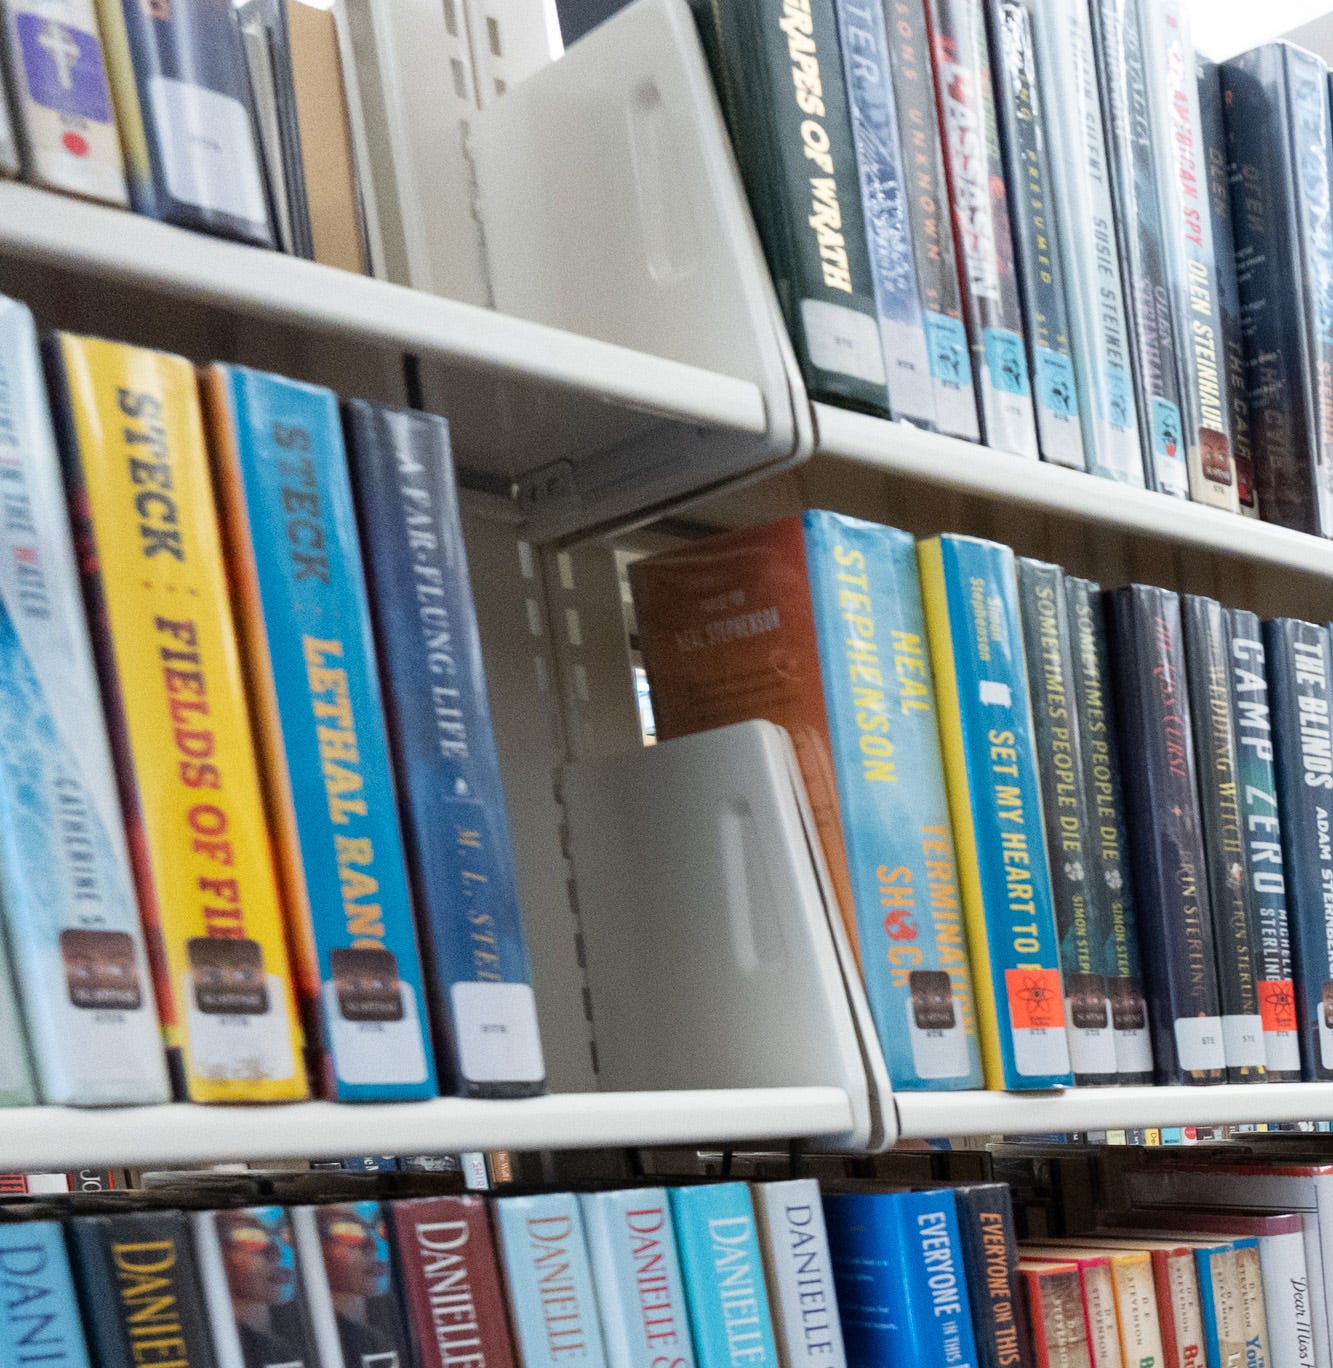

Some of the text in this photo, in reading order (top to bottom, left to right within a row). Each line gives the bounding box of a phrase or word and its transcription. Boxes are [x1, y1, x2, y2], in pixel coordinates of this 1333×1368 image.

[800, 123, 854, 294] OF WRATH
[1187, 260, 1209, 320] OLEN
[115, 387, 232, 862] STECK FIELDS OF
[269, 421, 367, 825] STECK LETHAL
[399, 482, 470, 762] FAR-FLUNG LIFE
[833, 545, 898, 784] STEPHENSON
[889, 629, 930, 716] NEAL
[1035, 586, 1082, 851] SOMETIMES PEOPLE DIE
[1075, 603, 1120, 860] SOMETIMES PEOPLE DIE
[988, 728, 1039, 956] SET MY HEART TO
[1231, 637, 1283, 894] CAMP ZERO
[1292, 639, 1323, 695] THE
[1315, 805, 1333, 862] ADAM
[525, 1214, 587, 1363] DANIELLE
[625, 1207, 682, 1352] DANIELLE
[784, 1203, 836, 1359] DANIELLE
[917, 1211, 961, 1318] EVERYONE
[978, 1212, 1010, 1301] EVERYONE
[996, 1325, 1019, 1360] THIS
